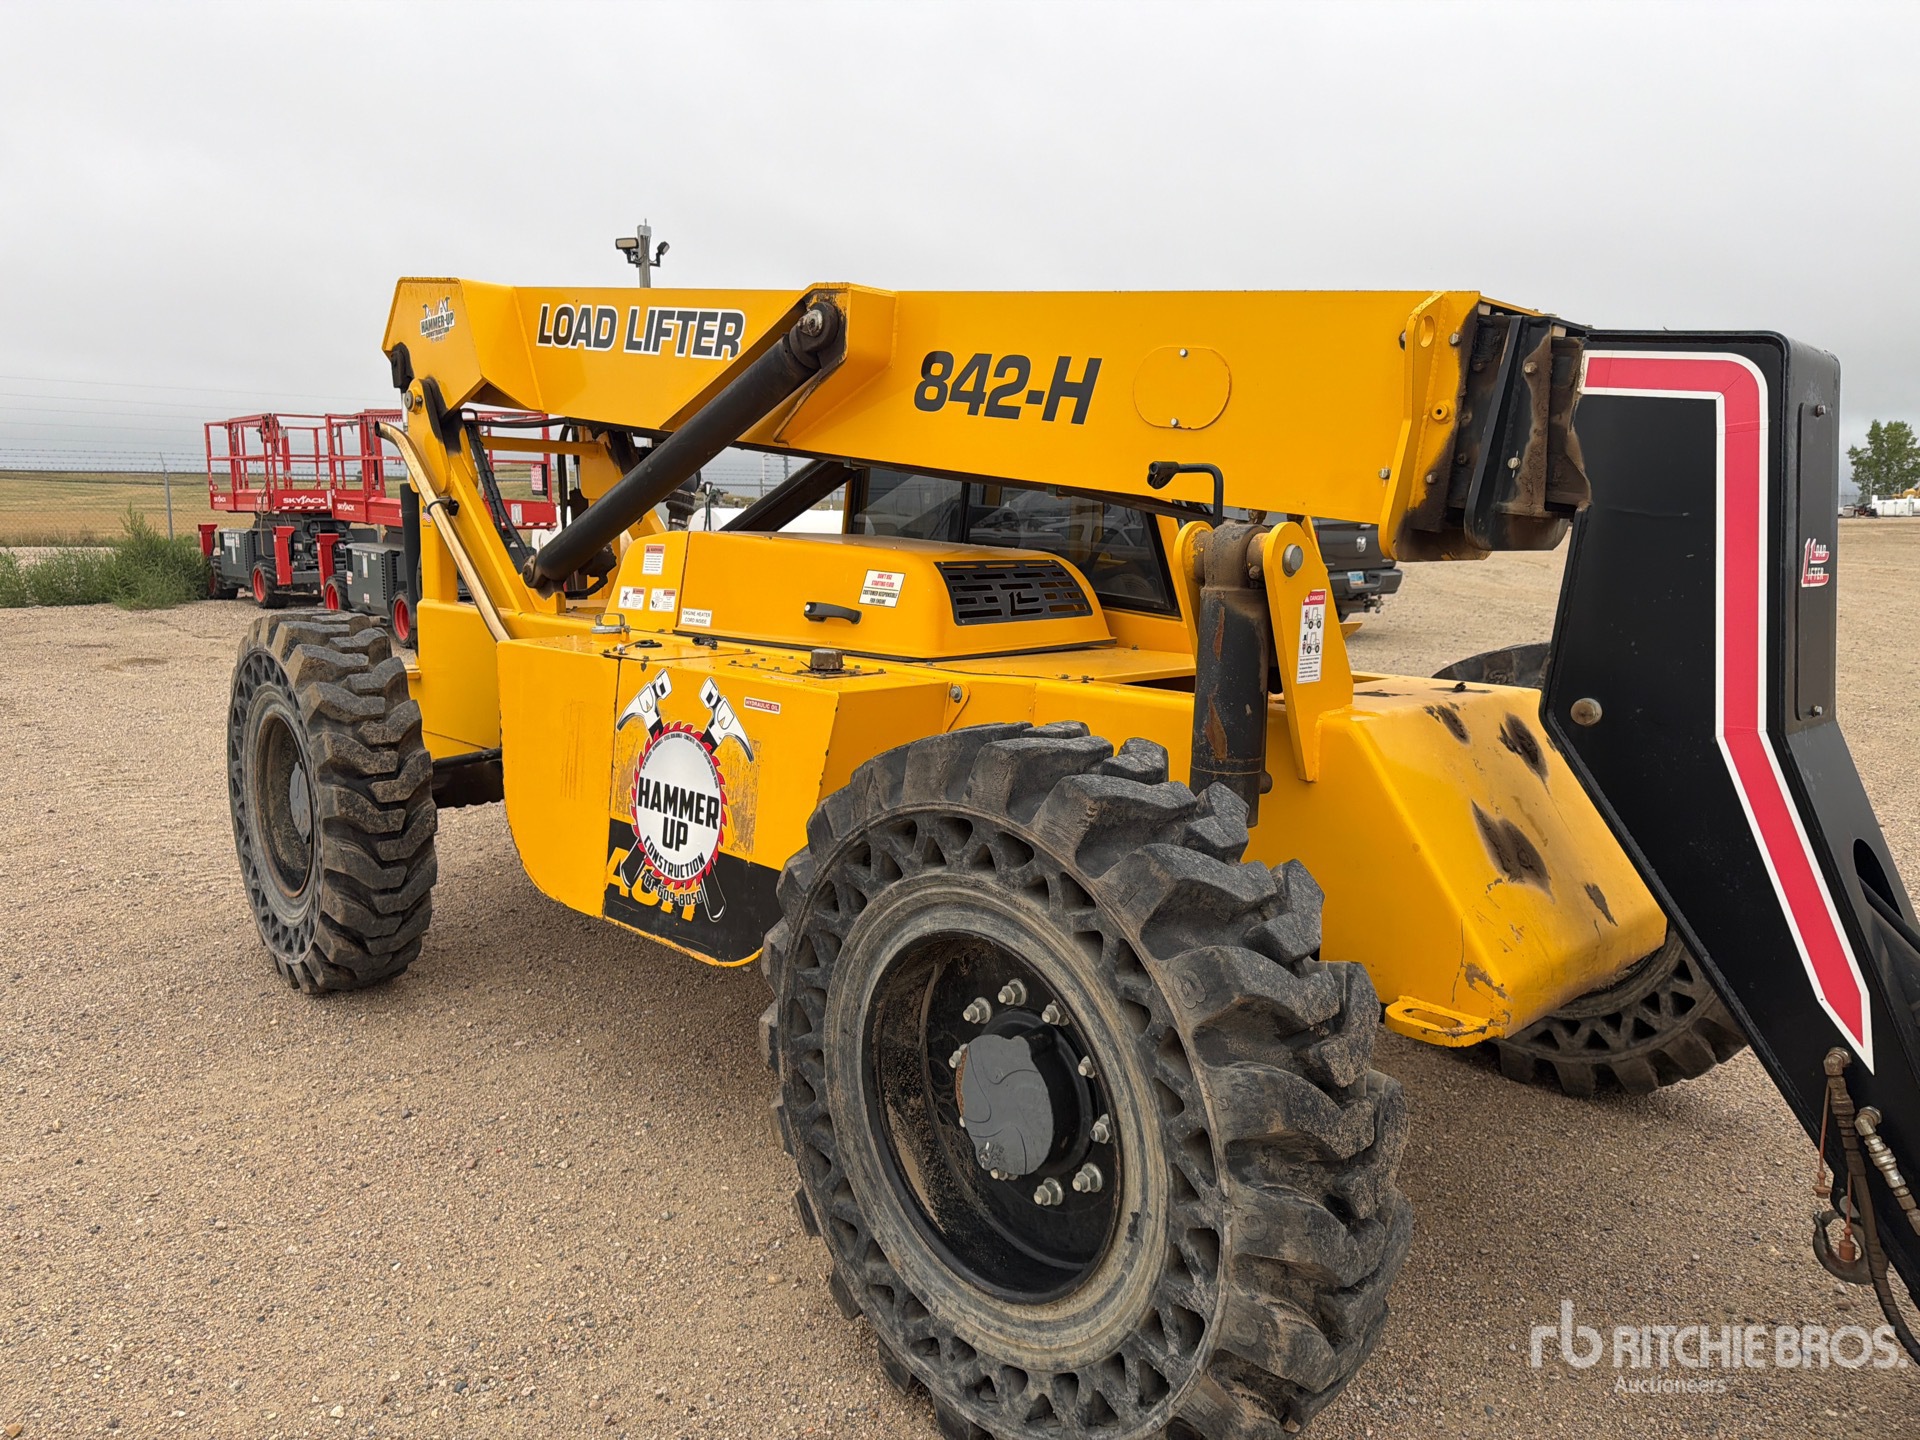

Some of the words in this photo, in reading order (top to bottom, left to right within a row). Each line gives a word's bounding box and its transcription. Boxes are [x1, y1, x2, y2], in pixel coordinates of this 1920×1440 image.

[538, 303, 617, 351] LOAD
[624, 305, 745, 361] LIFTER
[914, 350, 1102, 425] 842-H
[283, 495, 326, 505] SKYJACK
[746, 699, 770, 710] HYDRAULIC
[637, 776, 720, 830] HAMMER
[643, 834, 706, 879] CONSTRUCTION
[661, 816, 689, 852] UP
